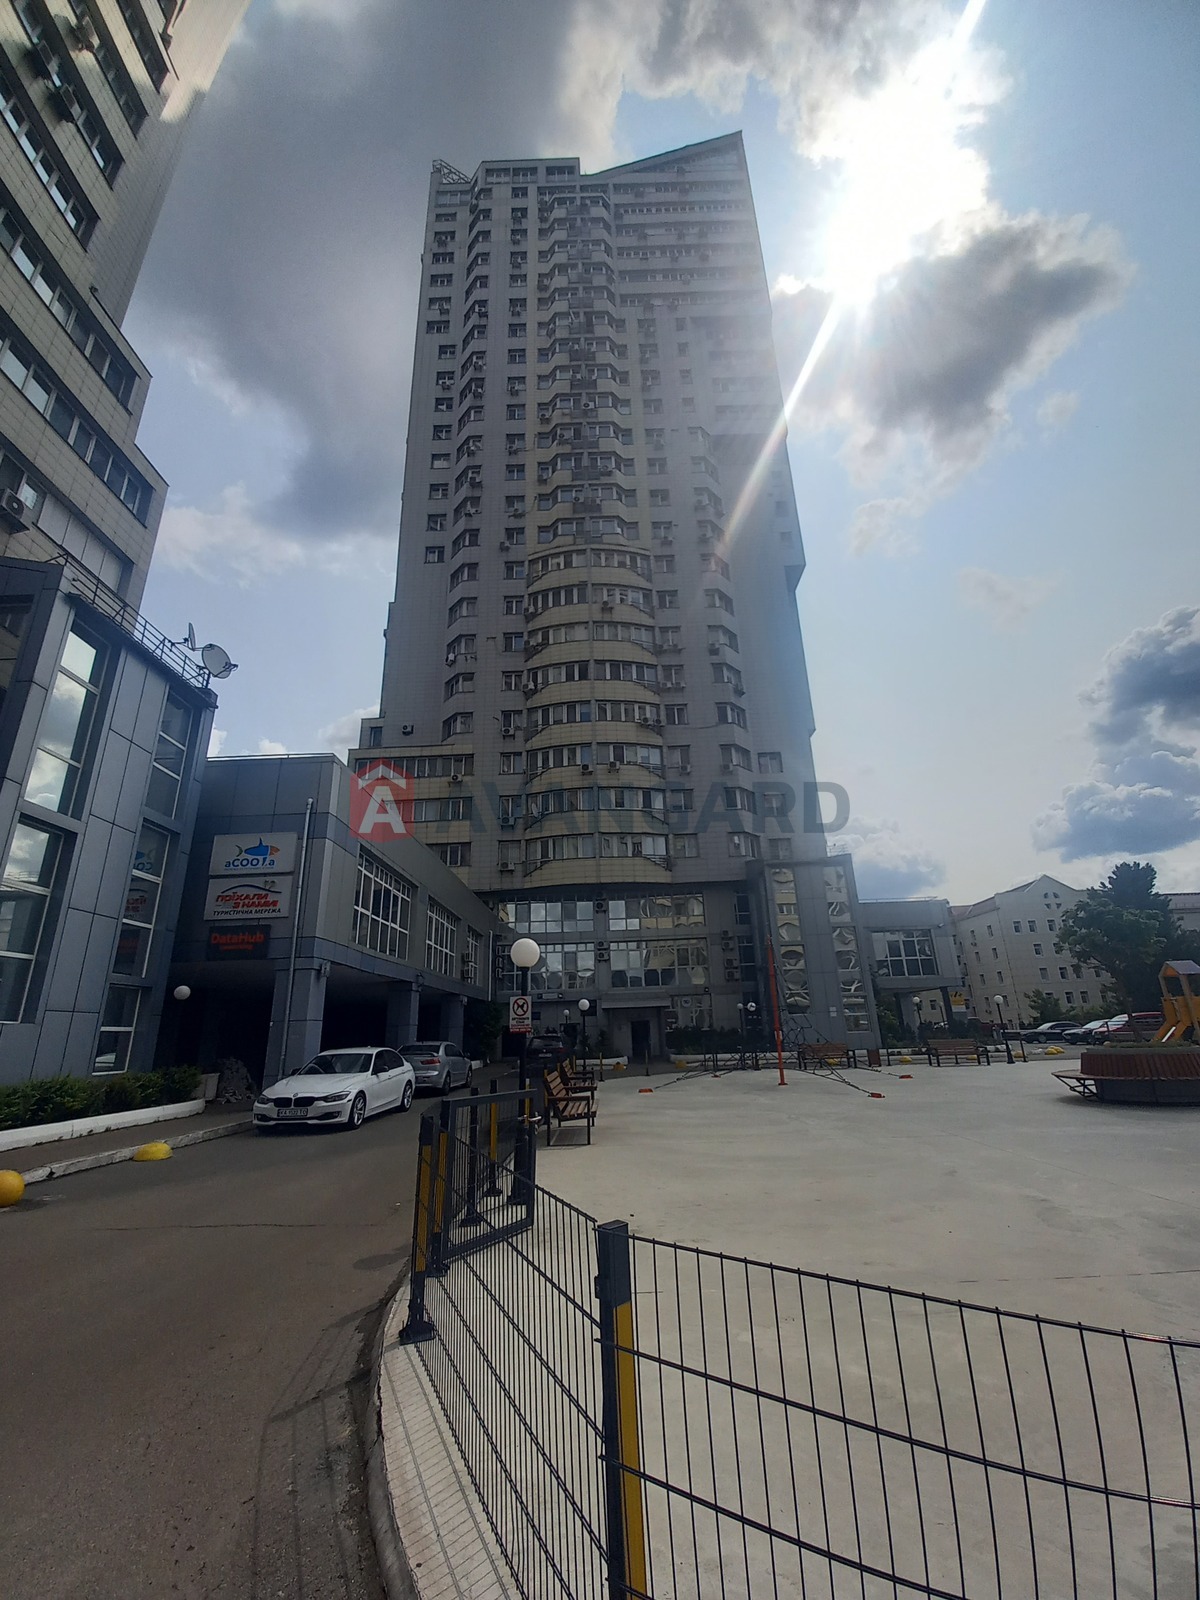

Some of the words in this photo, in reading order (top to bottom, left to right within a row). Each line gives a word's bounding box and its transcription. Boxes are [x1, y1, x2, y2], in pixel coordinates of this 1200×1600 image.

[215, 891, 269, 903] ПОЇХАЛИ
[241, 900, 279, 908] НАМИ
[213, 908, 253, 916] ТУРИСТИЧНА
